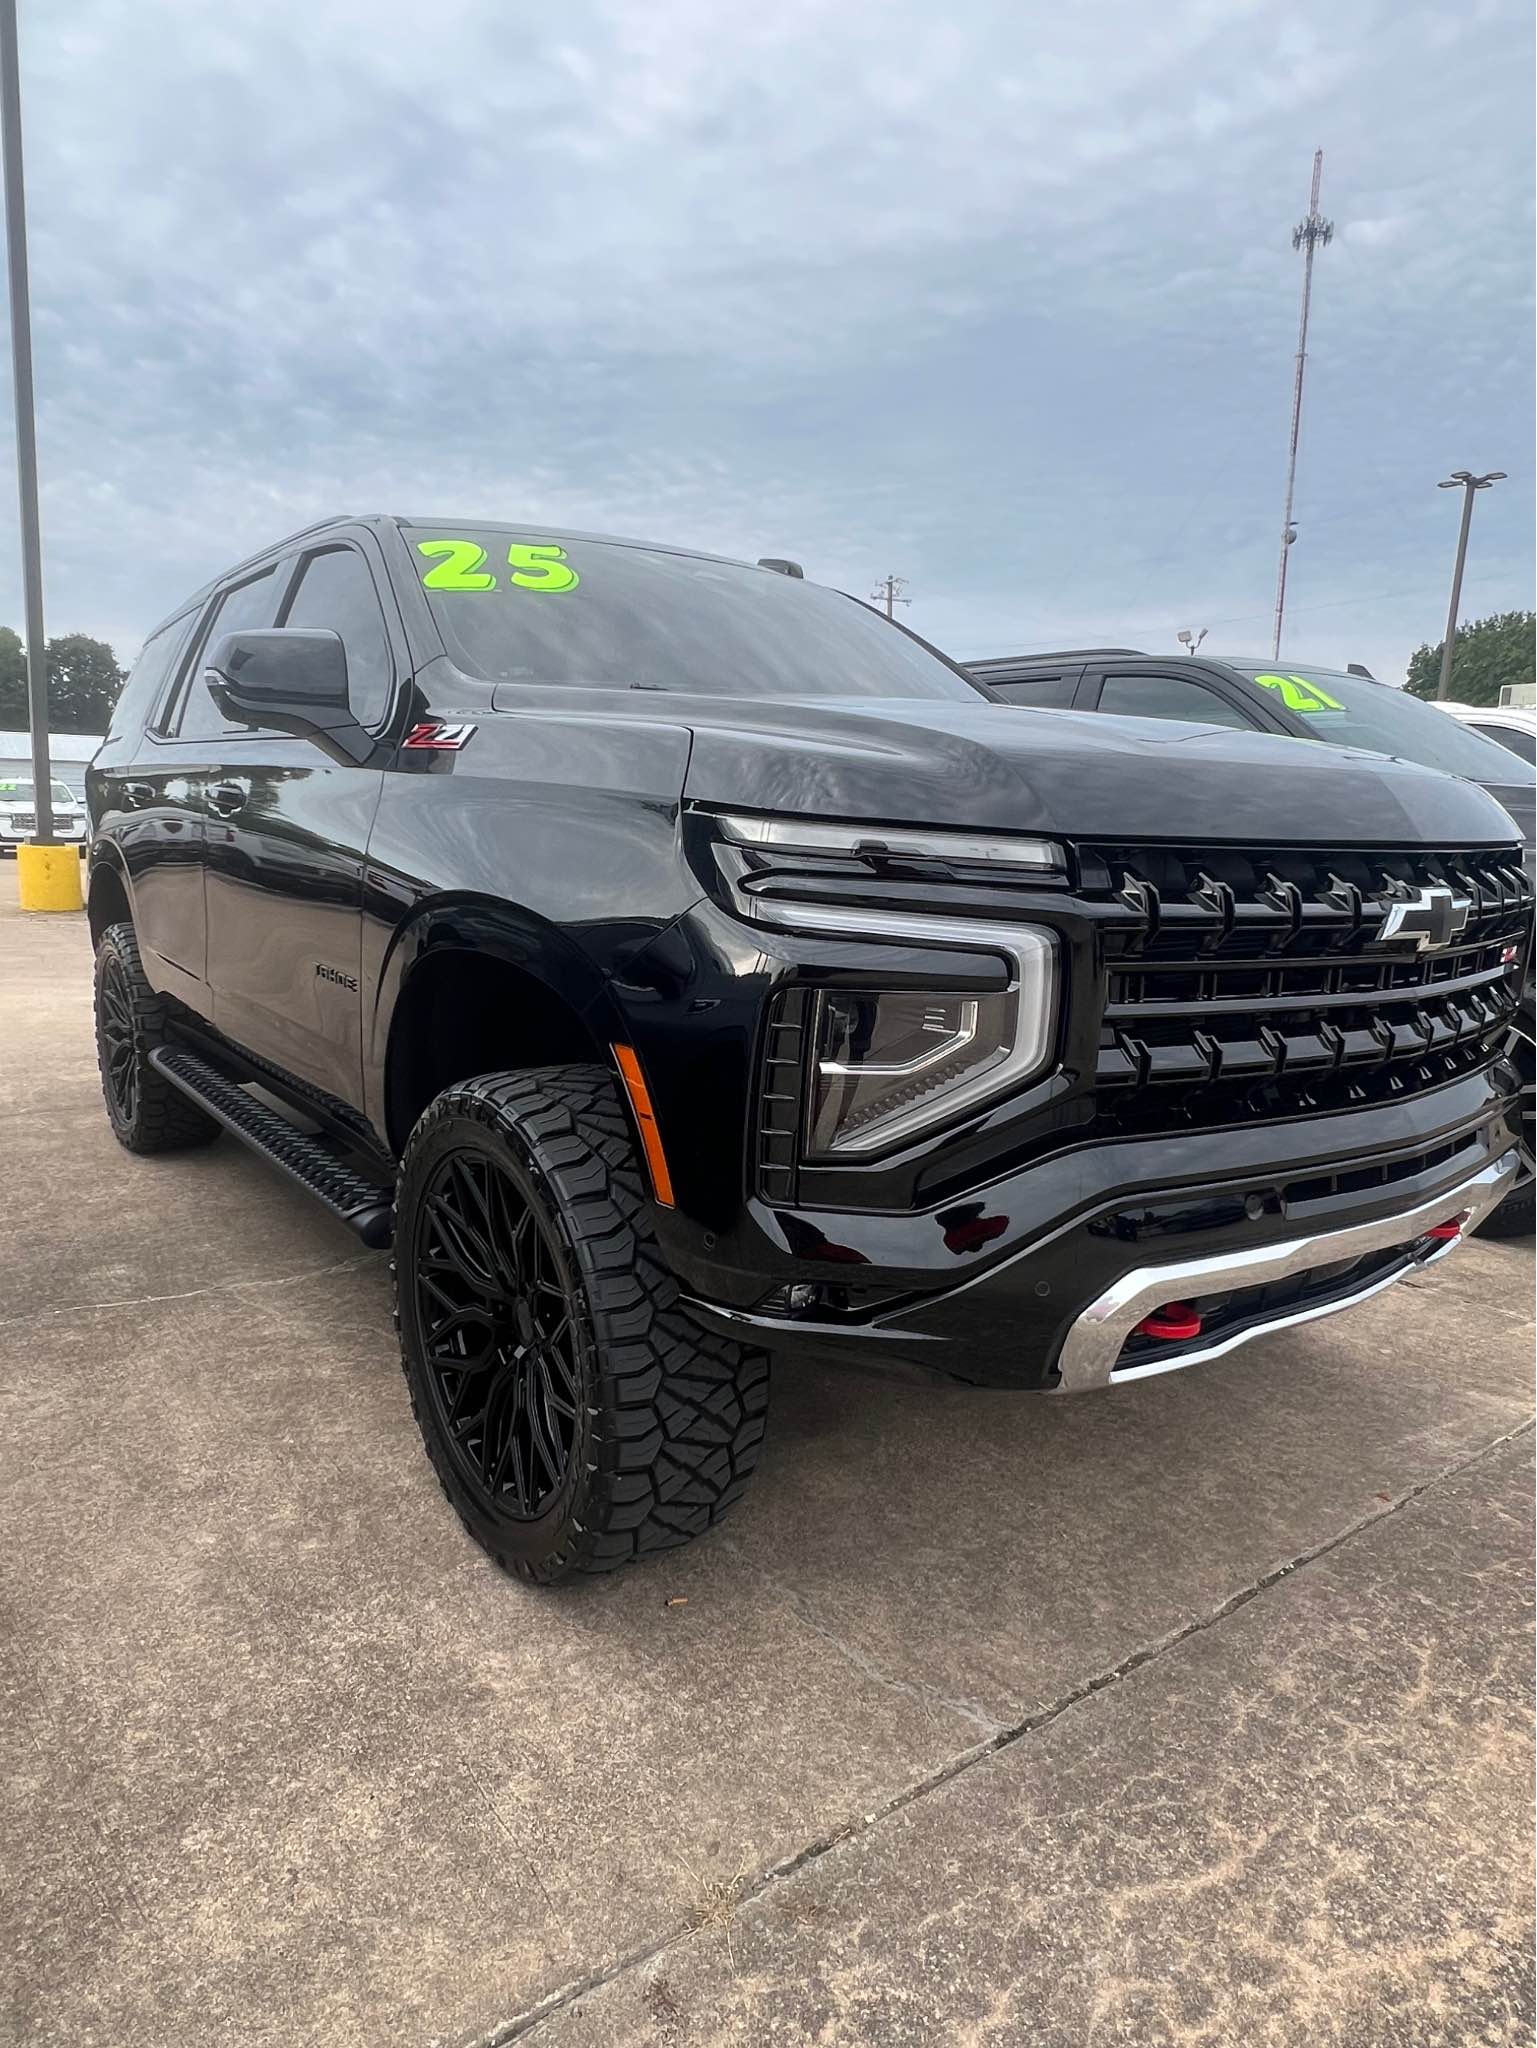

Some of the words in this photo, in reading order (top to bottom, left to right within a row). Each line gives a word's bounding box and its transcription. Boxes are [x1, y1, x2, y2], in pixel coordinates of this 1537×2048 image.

[417, 540, 579, 592] 25
[1254, 675, 1347, 712] 21
[401, 724, 478, 750] Z71
